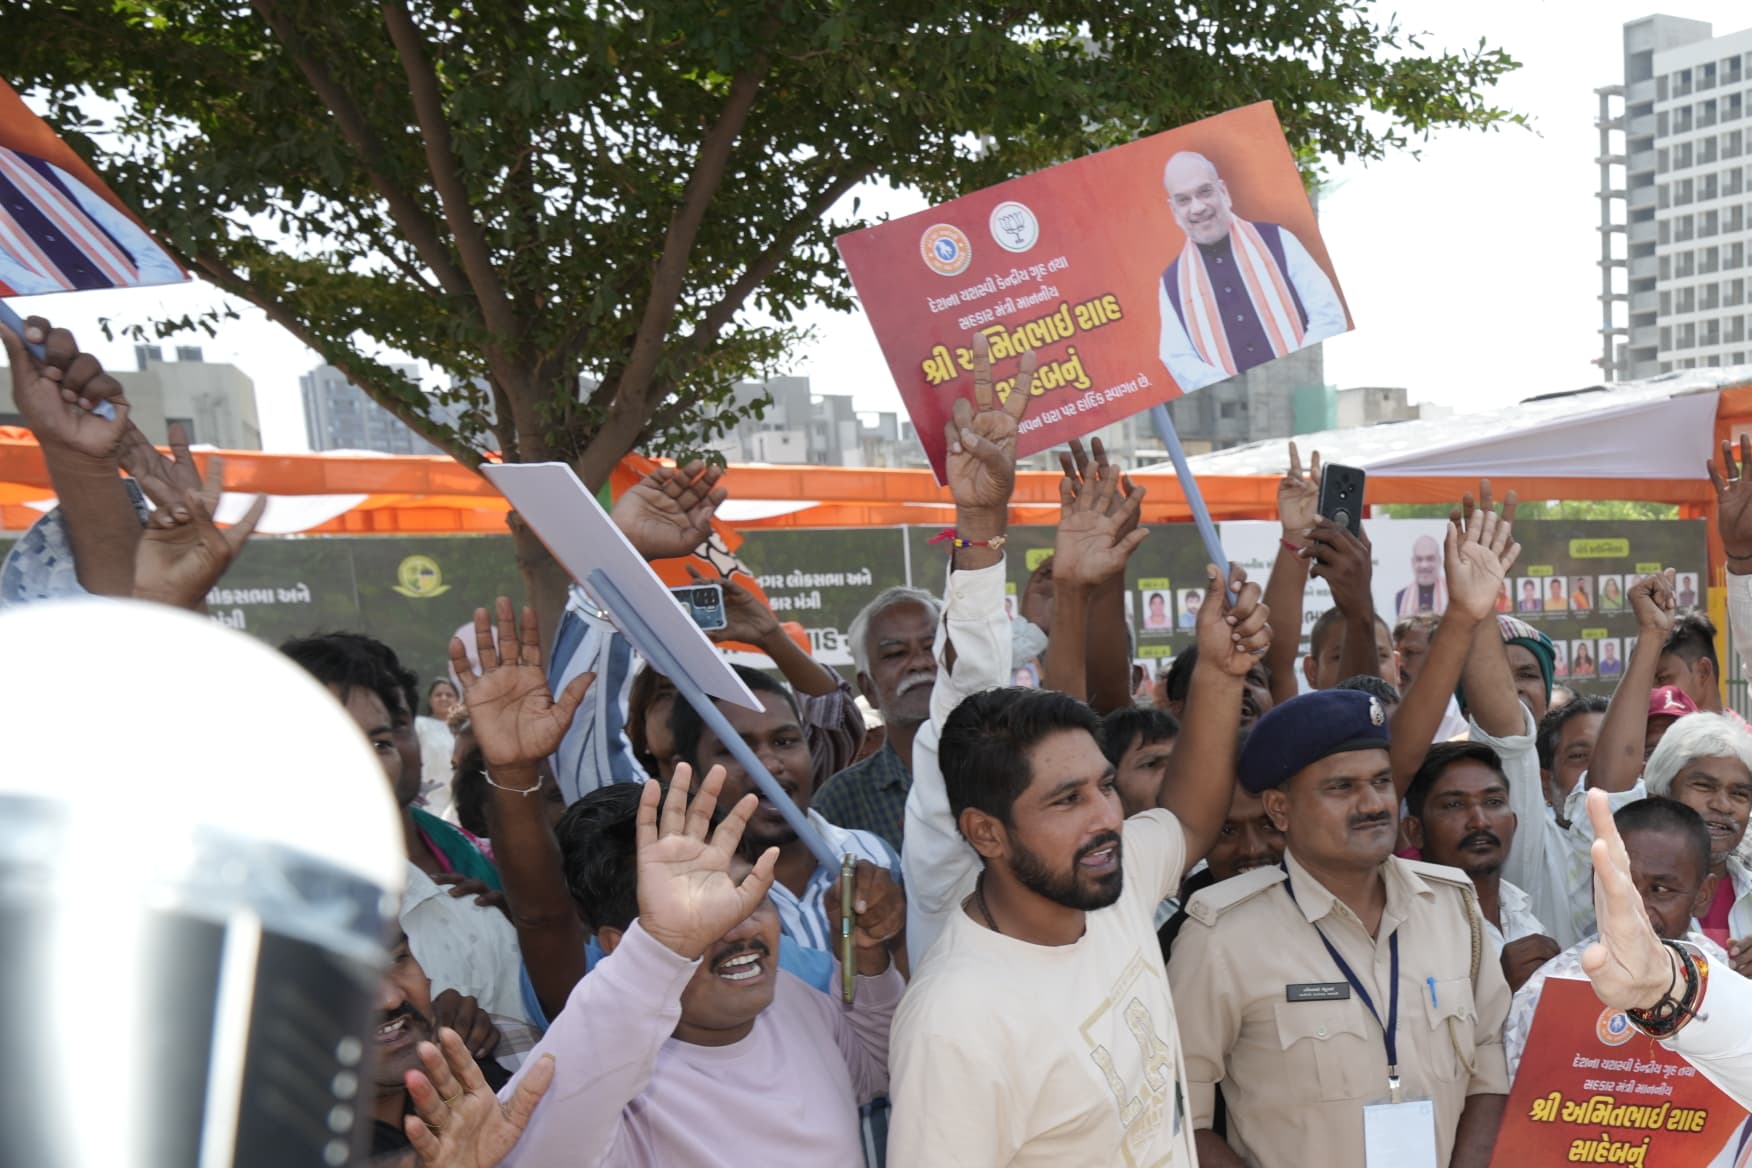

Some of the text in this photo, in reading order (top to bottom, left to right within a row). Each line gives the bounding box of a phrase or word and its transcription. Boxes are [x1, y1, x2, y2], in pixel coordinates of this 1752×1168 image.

[928, 293, 961, 313] દેશના
[960, 279, 997, 303] યશસ્વી
[1029, 264, 1050, 283] ગૃહ
[1048, 256, 1069, 273] તથા
[958, 286, 1060, 331] સહકાર મંત્રી માનનીય
[921, 345, 958, 384] શ્રી
[1077, 294, 1122, 330] શાહ
[1043, 405, 1062, 426] ધરા
[1062, 400, 1077, 418] પર
[1104, 382, 1137, 404] સ્વાગત
[277, 581, 311, 604] અને
[786, 569, 844, 588] લોકસભા
[846, 567, 872, 586] અને
[793, 590, 822, 610] મંત્રી
[1572, 1053, 1600, 1069] દેશના
[1601, 1056, 1634, 1072] યશસ્વી
[1662, 1064, 1677, 1079] ગૃહ
[1678, 1066, 1696, 1078] તથા
[1583, 1079, 1673, 1096] સહકાર મંત્રી માનનીય
[1528, 1092, 1707, 1132] શ્રી અમિતભાઈ શાહ
